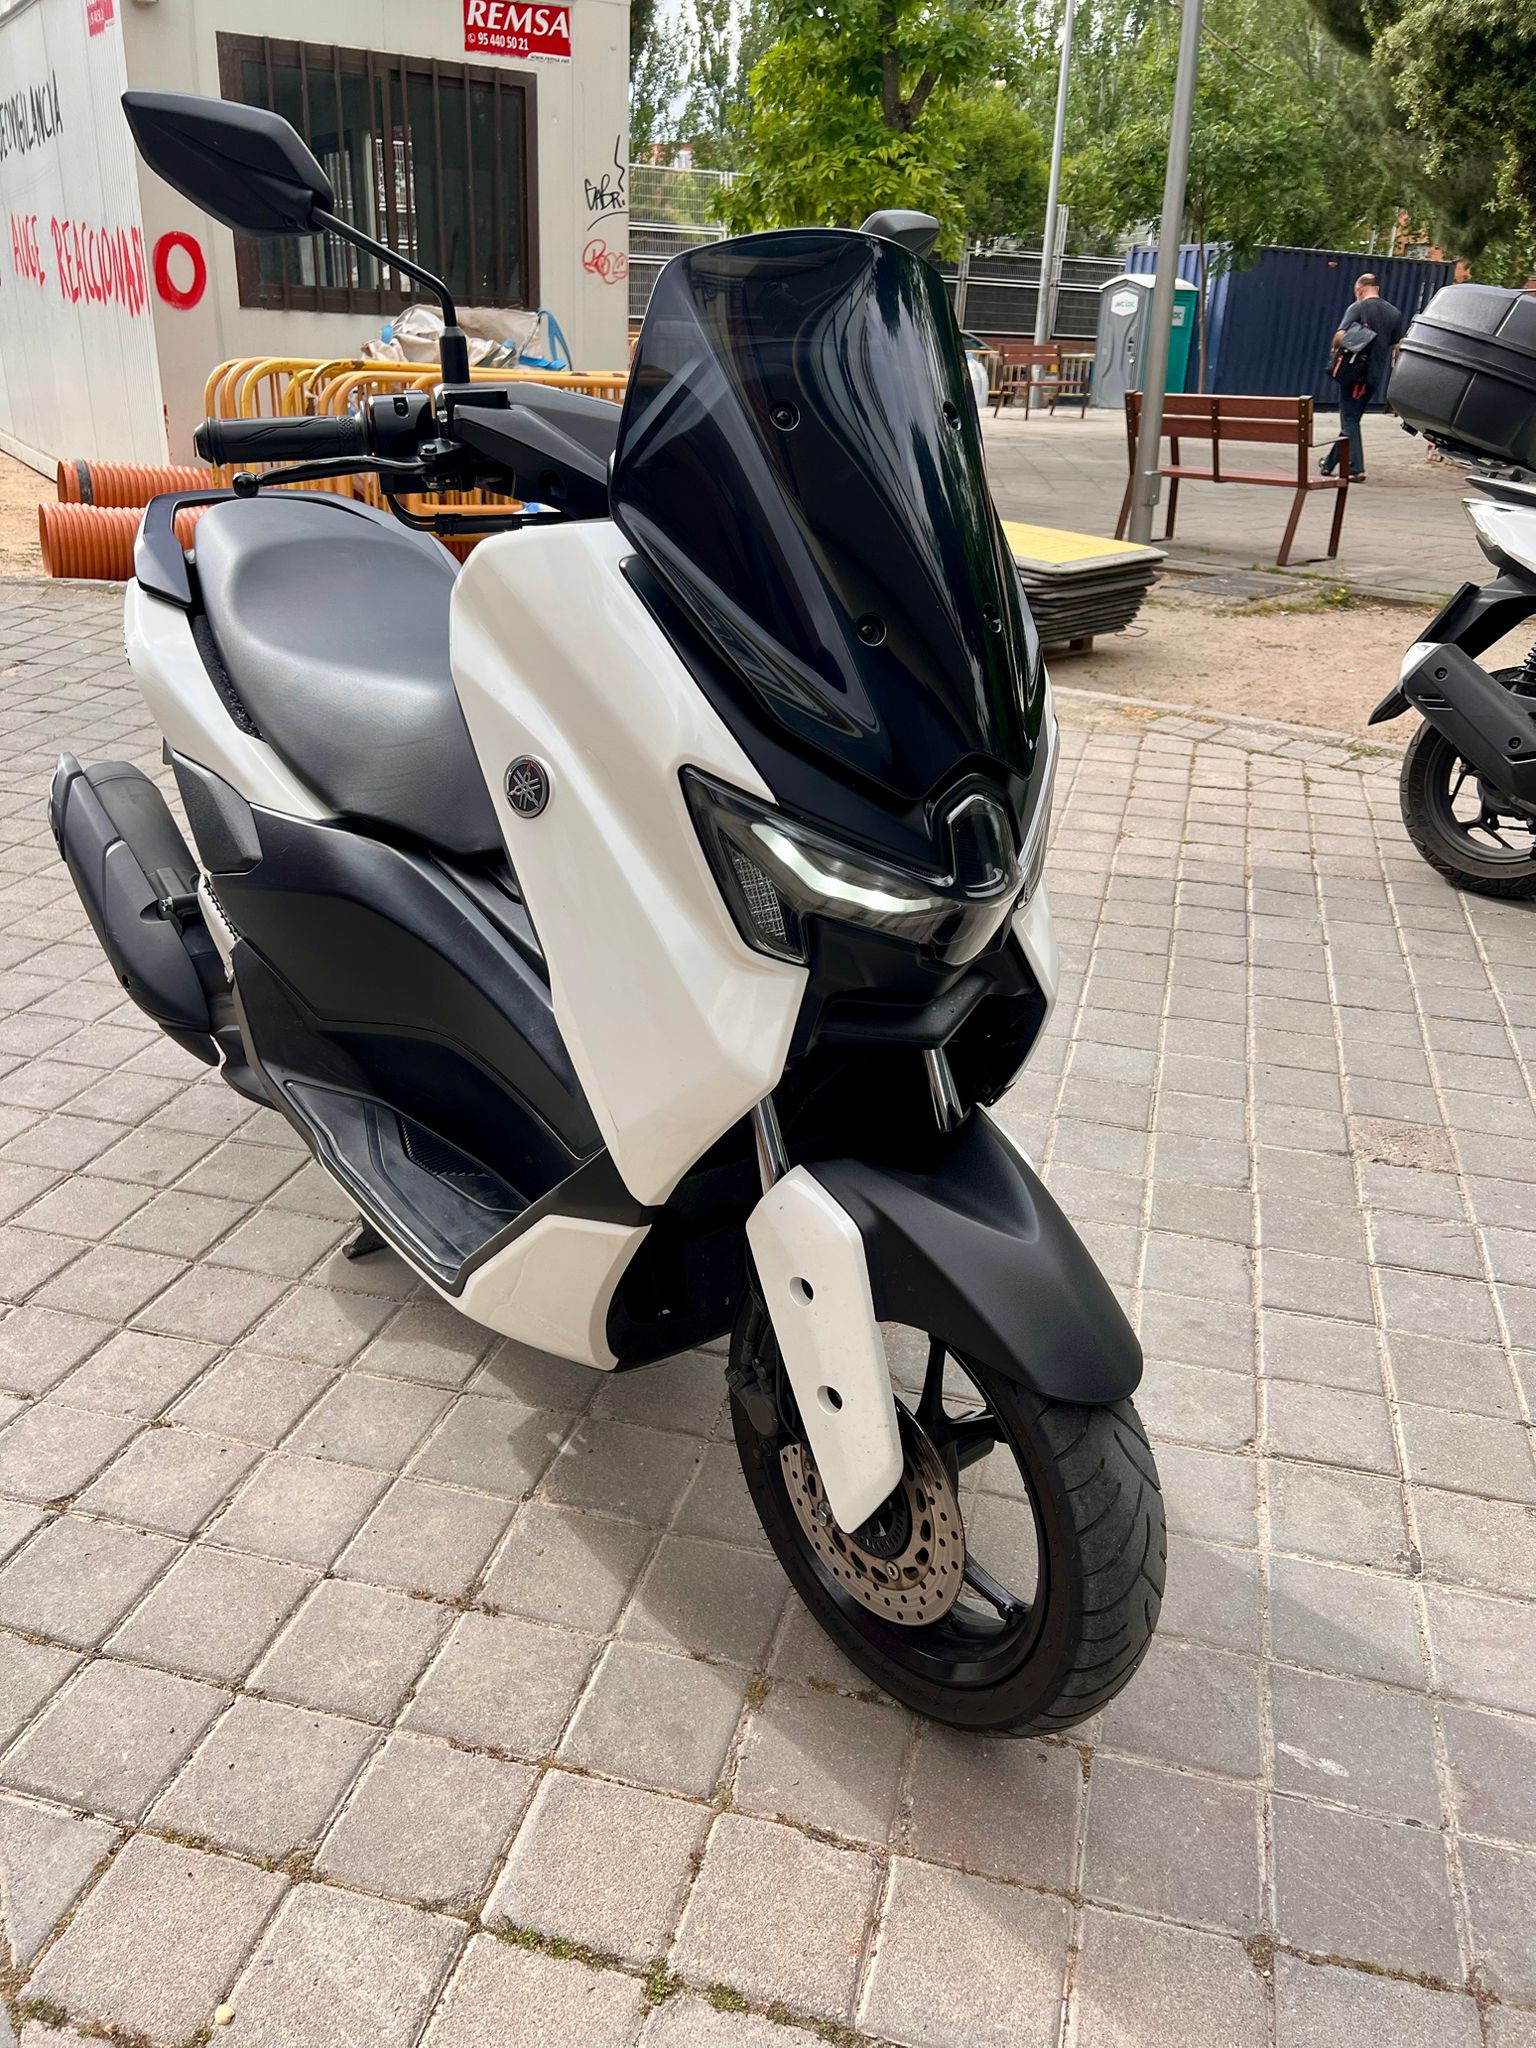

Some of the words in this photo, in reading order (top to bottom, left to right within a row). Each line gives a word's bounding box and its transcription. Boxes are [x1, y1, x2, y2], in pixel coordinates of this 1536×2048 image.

[466, 0, 569, 38] REMSA
[477, 32, 489, 46] 95
[490, 33, 506, 48] 440
[506, 36, 518, 50] 50
[518, 37, 529, 51] 21
